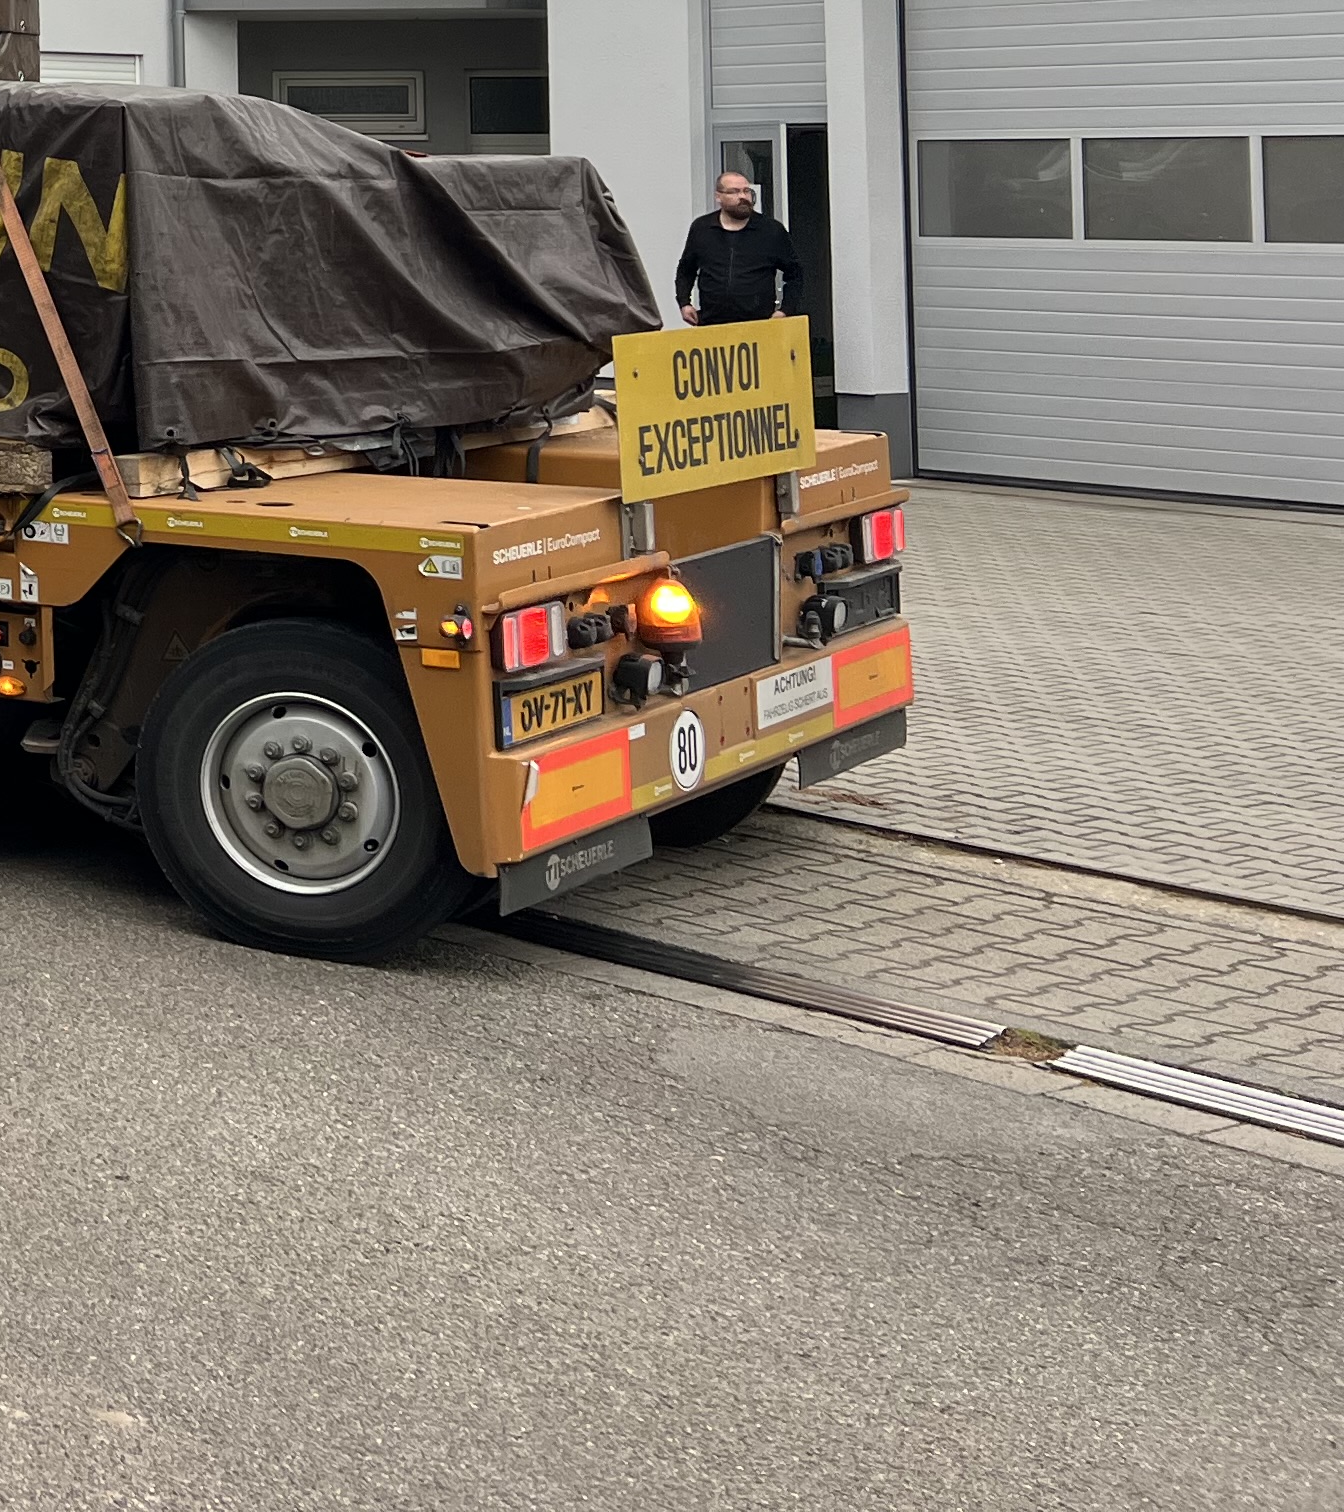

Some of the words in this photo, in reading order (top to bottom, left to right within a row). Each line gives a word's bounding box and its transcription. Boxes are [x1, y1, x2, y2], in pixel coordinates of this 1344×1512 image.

[672, 341, 760, 401] CONVOI
[638, 402, 800, 477] EXCEPTIONNEL
[493, 540, 543, 565] SCHEUERLE
[547, 528, 601, 553] EuroCompact
[773, 665, 817, 696] ACHTUNG!
[677, 723, 698, 775] 80
[560, 839, 615, 877] SCHEUERLE
